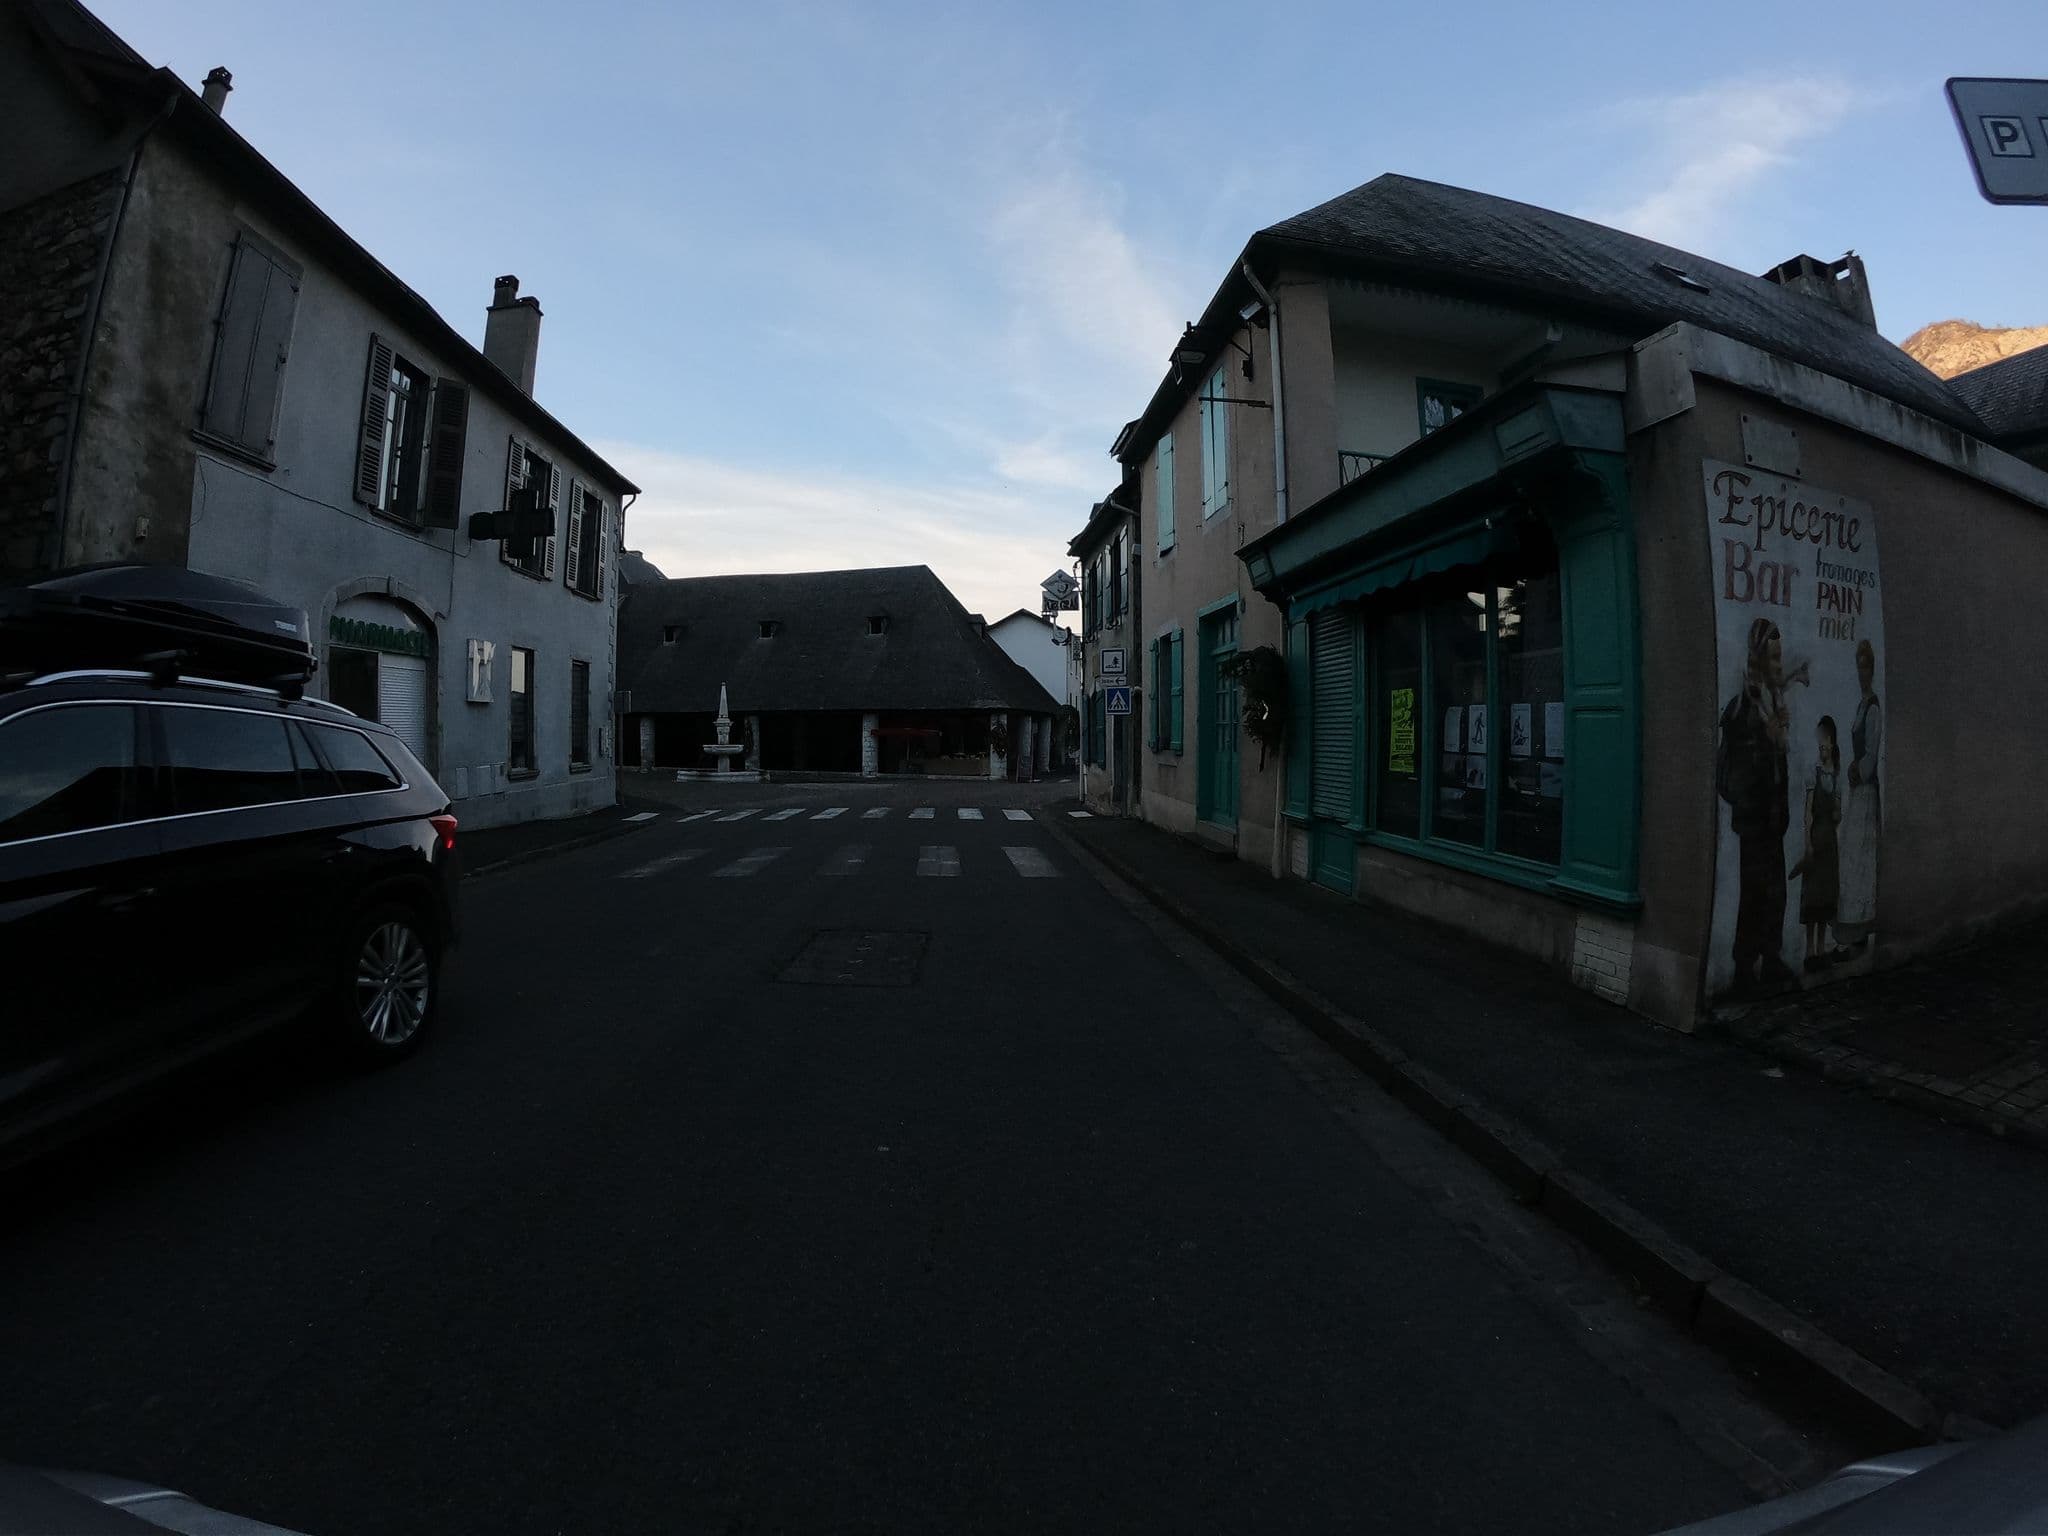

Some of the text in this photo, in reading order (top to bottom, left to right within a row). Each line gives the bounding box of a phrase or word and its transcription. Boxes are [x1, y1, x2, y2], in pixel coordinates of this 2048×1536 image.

[1990, 121, 2018, 152] P
[1714, 470, 1862, 552] Epicerie
[1723, 538, 1798, 607] Bar
[1816, 582, 1863, 616] PAIN
[1818, 616, 1856, 642] miel
